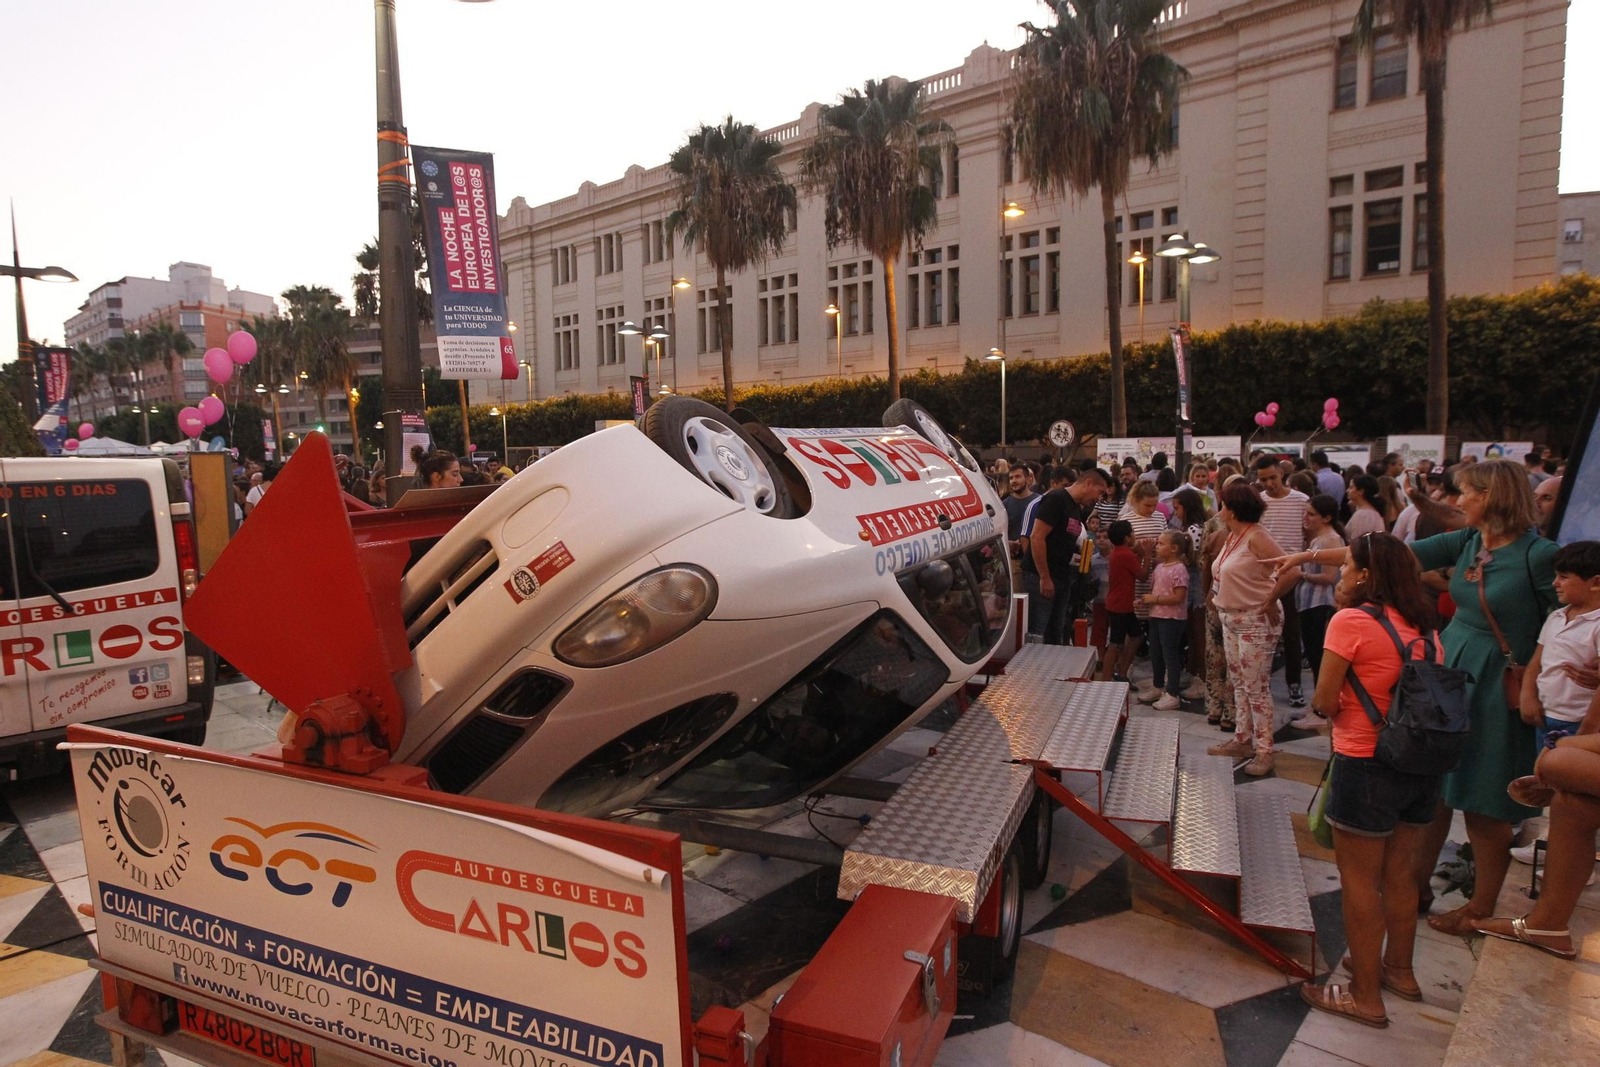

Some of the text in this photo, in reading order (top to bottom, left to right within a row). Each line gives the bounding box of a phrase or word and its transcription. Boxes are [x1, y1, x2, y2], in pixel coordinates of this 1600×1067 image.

[441, 211, 463, 288] LA NOCHE
[452, 166, 480, 289] EUROPEA DE L@S
[469, 167, 496, 290] INVESTIGADOR@S
[453, 305, 484, 313] CIENCIA
[453, 314, 503, 322] UNIVERSIDAD
[504, 345, 514, 354] 65
[20, 485, 48, 498] EN
[54, 484, 66, 497] 6
[72, 483, 117, 496] DIAS
[875, 538, 930, 577] VUELCO
[933, 533, 947, 555] DE
[7, 591, 165, 624] OESCUELA
[38, 695, 55, 713] Te
[59, 669, 107, 703] recogemos
[50, 714, 64, 725] sin
[66, 679, 116, 714] compromiso
[454, 860, 635, 912] AUTOESCUELA
[103, 890, 238, 949] CUALIFICACIÓN
[263, 939, 396, 999] FORMACIÓN
[435, 990, 659, 1067] EMPLEABILIDAD
[114, 921, 219, 972] SIMULADOR
[221, 958, 248, 982] DE
[251, 963, 331, 1008] VUELCO
[347, 997, 435, 1043] PLANES
[442, 1027, 477, 1056] DE
